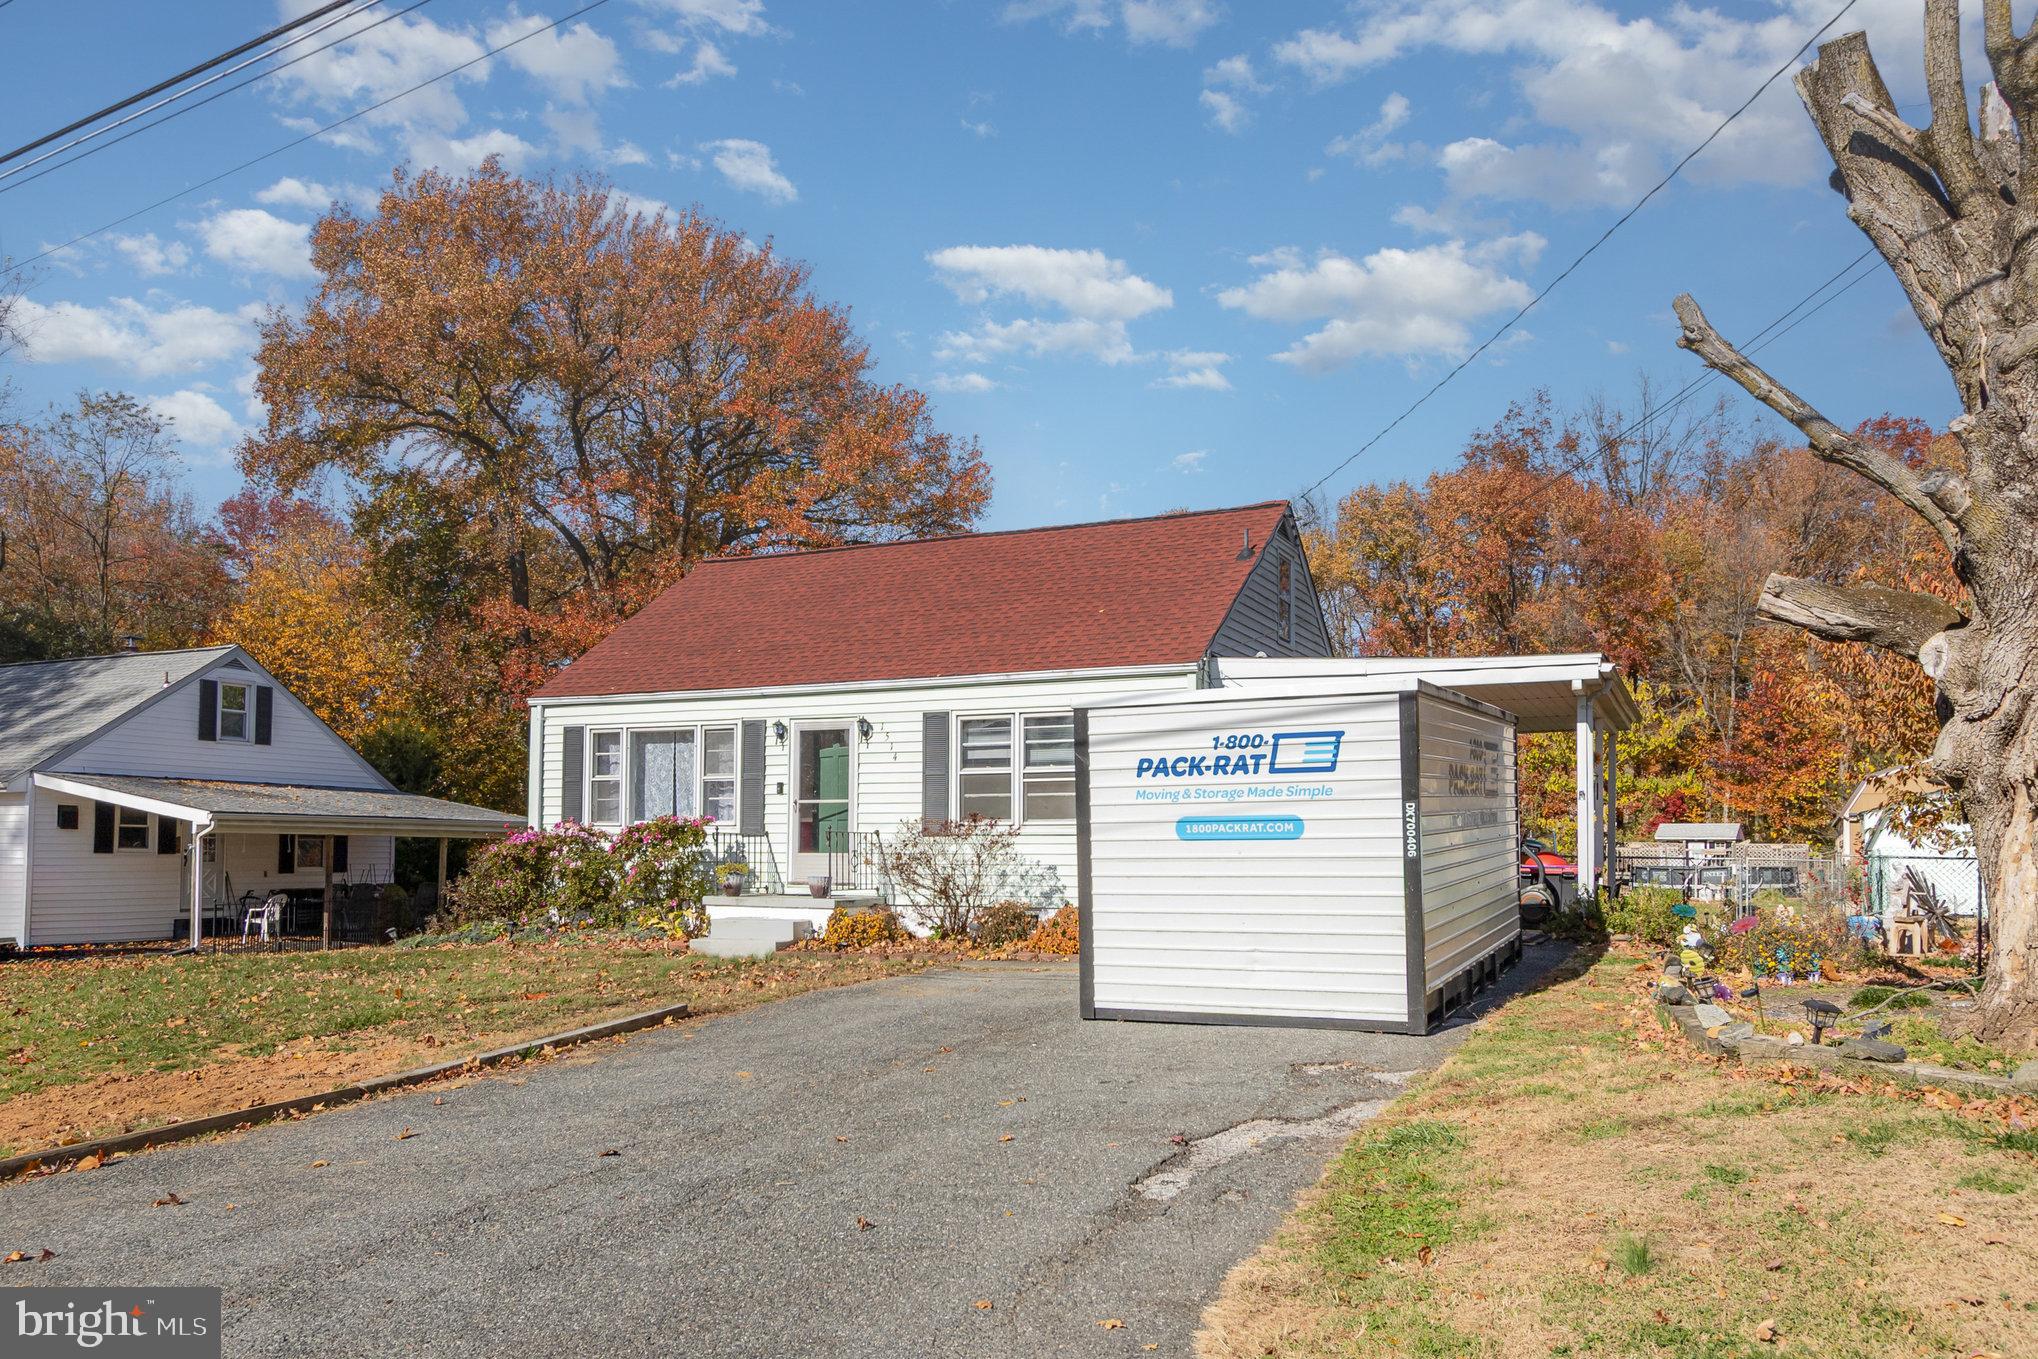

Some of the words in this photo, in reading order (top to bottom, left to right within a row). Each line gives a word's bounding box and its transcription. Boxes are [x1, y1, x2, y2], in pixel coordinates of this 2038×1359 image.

[1136, 754, 1268, 778] PACK-RAT
[1135, 788, 1180, 803] Moving
[1182, 789, 1192, 800] &
[1193, 787, 1245, 802] Storage
[1247, 785, 1284, 799] Made
[1285, 784, 1334, 801] Simple
[1185, 822, 1295, 835] 1800PACKRAT.COM
[1405, 802, 1417, 858] DX700406
